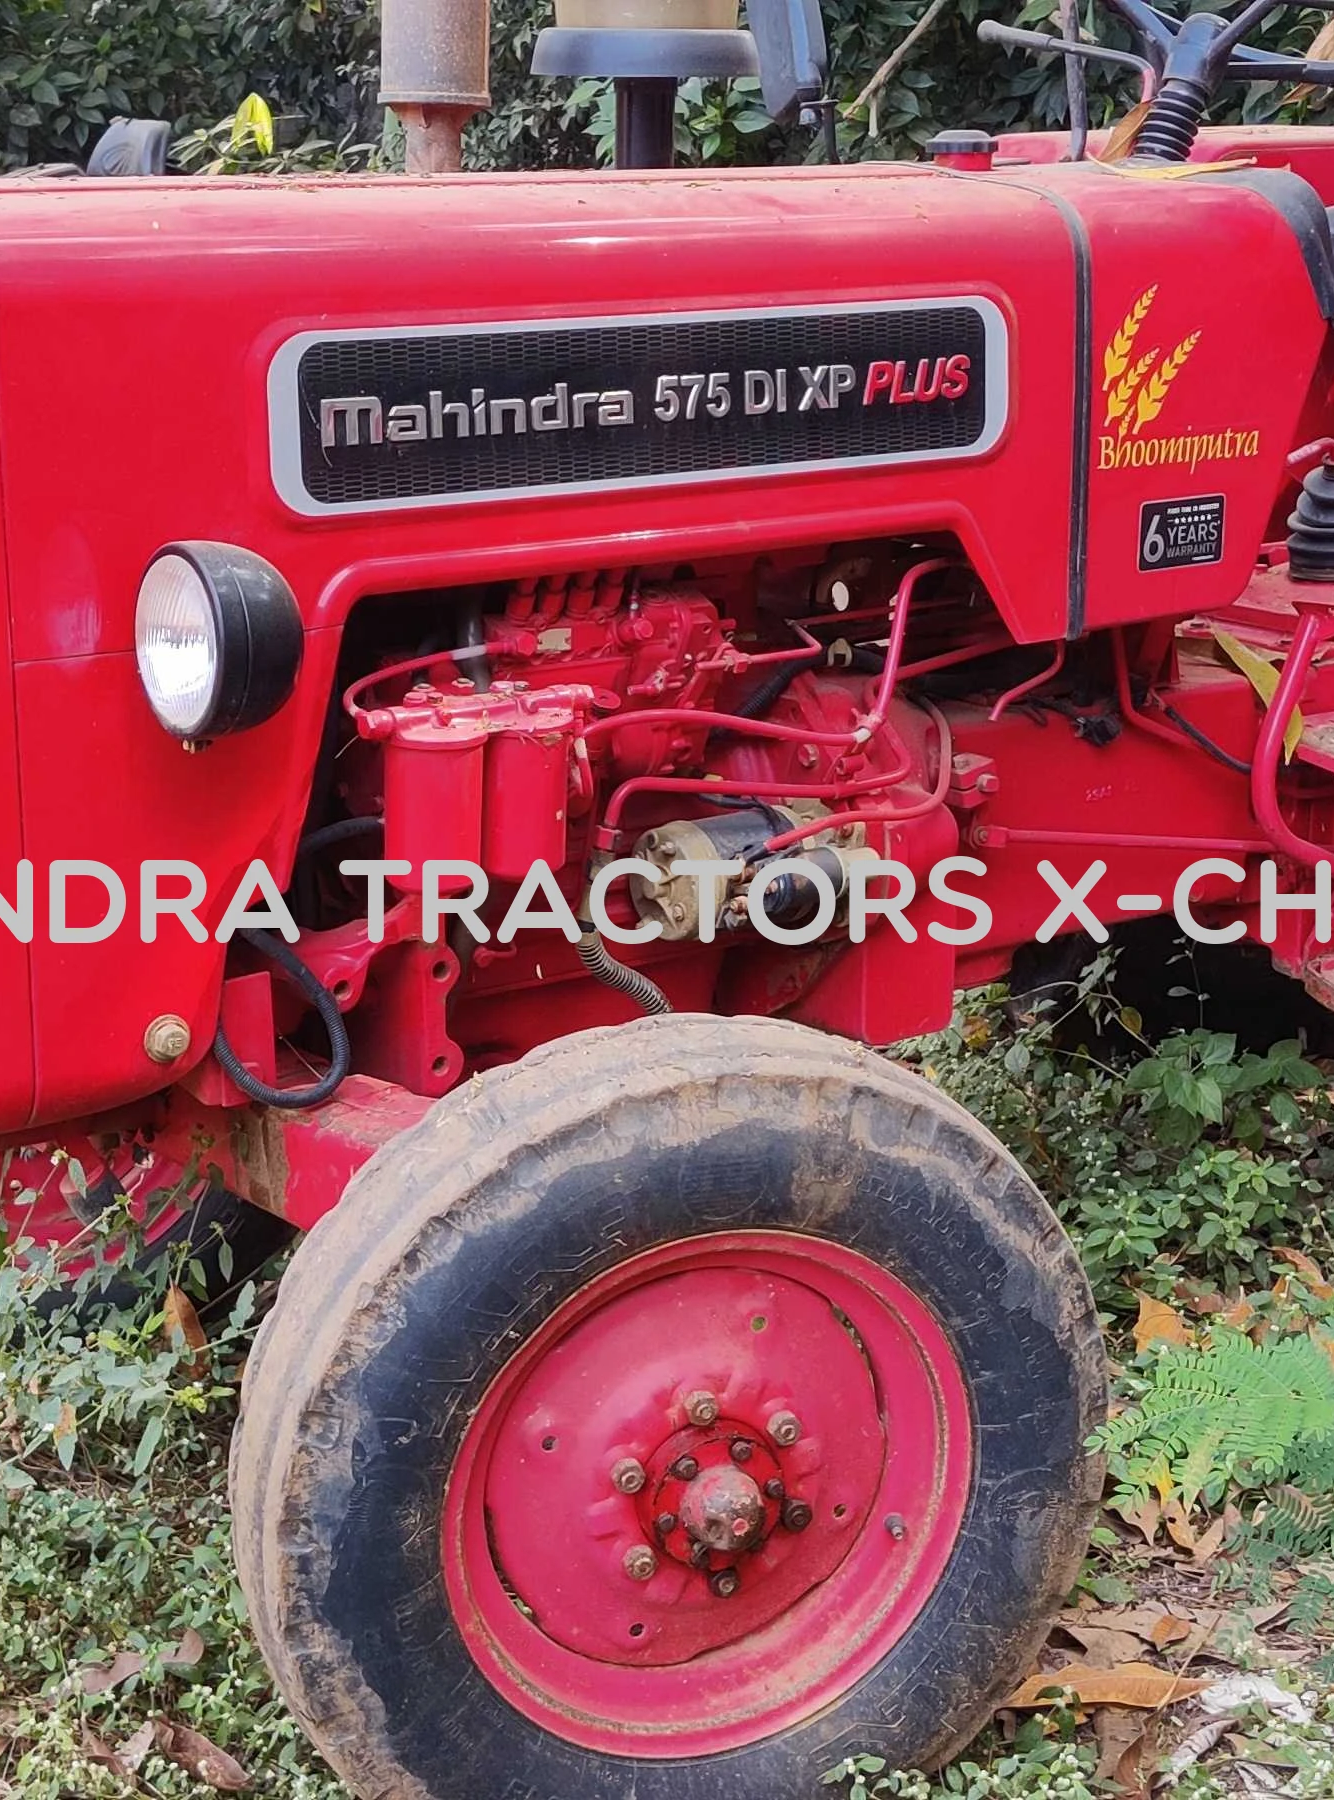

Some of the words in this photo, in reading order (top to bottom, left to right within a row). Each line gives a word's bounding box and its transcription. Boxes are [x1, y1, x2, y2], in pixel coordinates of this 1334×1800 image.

[320, 382, 634, 448] Mahindra
[654, 372, 732, 422] 575
[743, 368, 788, 416] DI
[796, 363, 857, 412] XP
[863, 354, 971, 407] PLUS
[1097, 423, 1260, 475] Bhoomiputra
[1143, 514, 1165, 563] 6
[1167, 542, 1217, 558] WARRANTY
